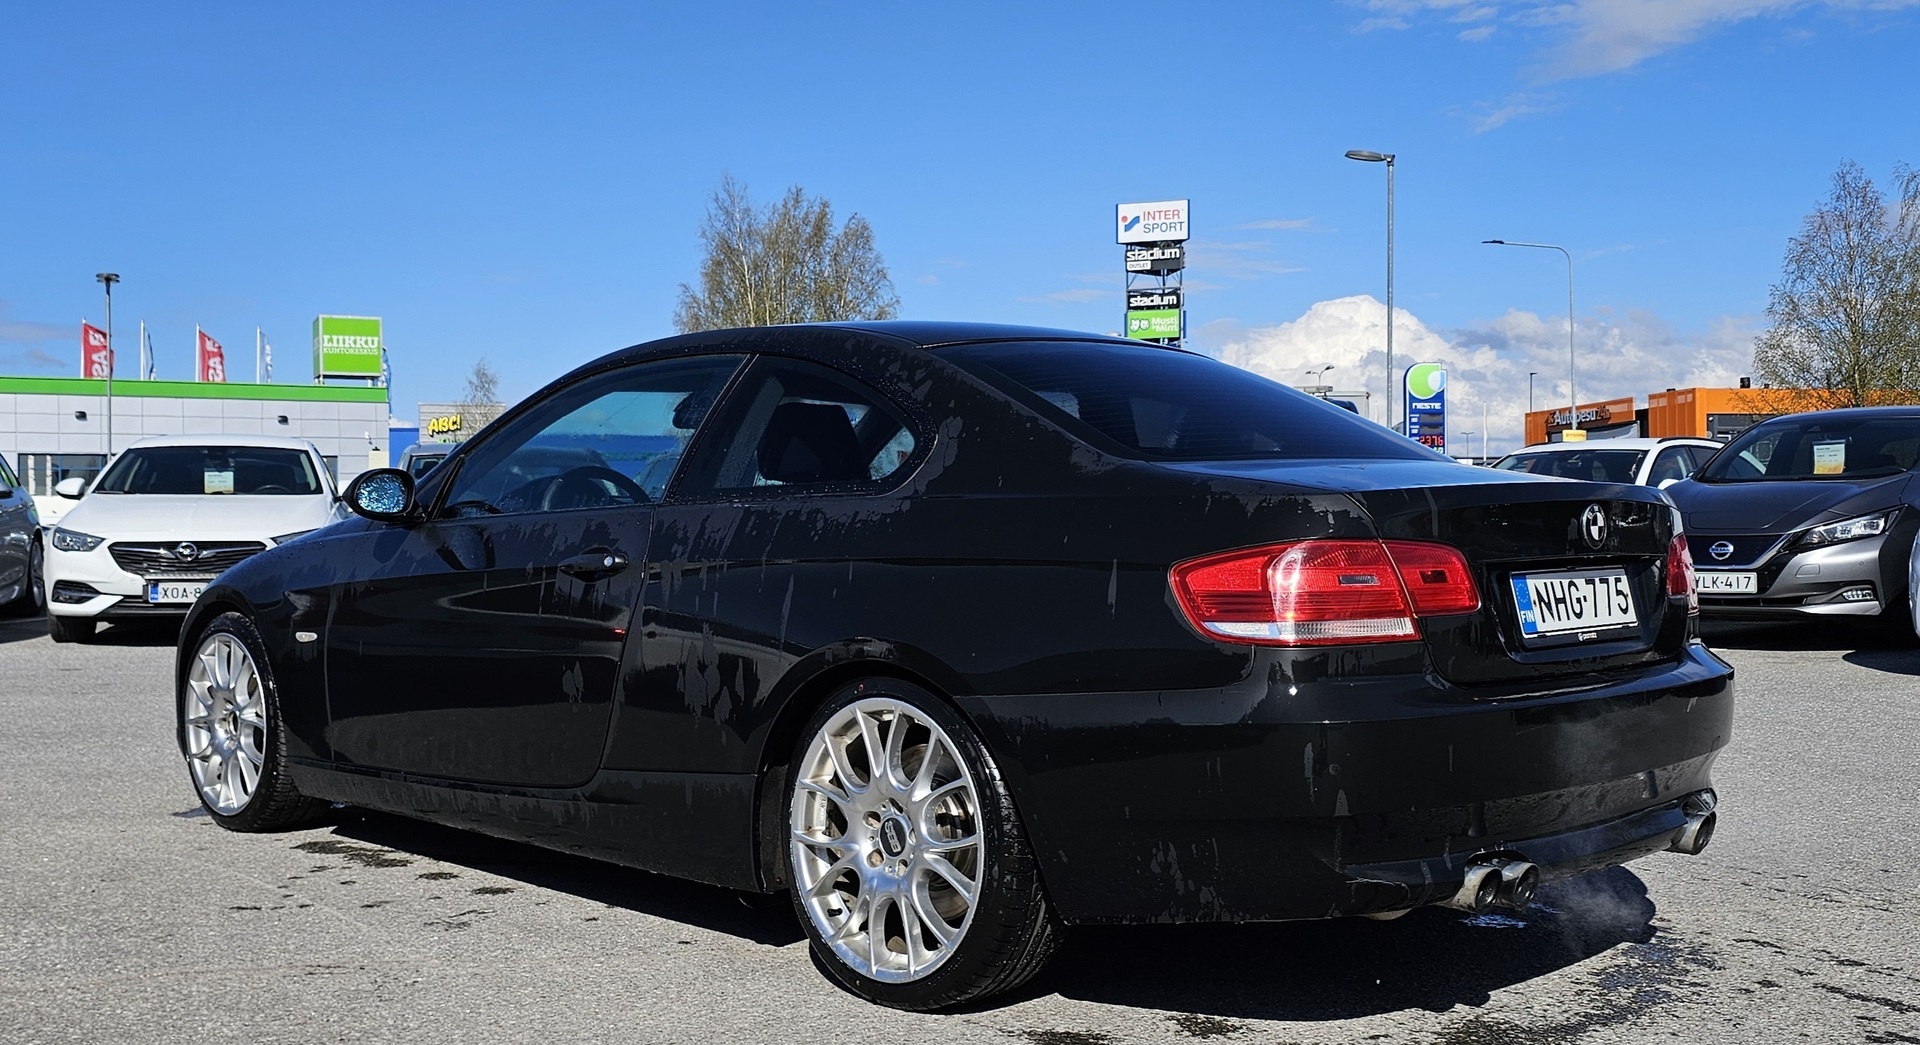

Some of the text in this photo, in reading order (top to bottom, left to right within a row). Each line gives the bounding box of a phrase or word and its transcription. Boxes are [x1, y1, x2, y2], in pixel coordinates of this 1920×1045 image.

[1143, 209, 1180, 221] INTER
[1143, 221, 1185, 233] SPORT
[1126, 247, 1180, 261] stadium
[1130, 294, 1177, 307] stadium
[1151, 316, 1177, 325] Musti
[322, 334, 379, 349] LIIKKU
[323, 347, 379, 355] KUNTOKESKUS
[427, 413, 461, 437] ABC!
[1695, 576, 1751, 589] YLK-417
[1534, 577, 1629, 623] NHG-775
[1521, 610, 1535, 623] FIN
